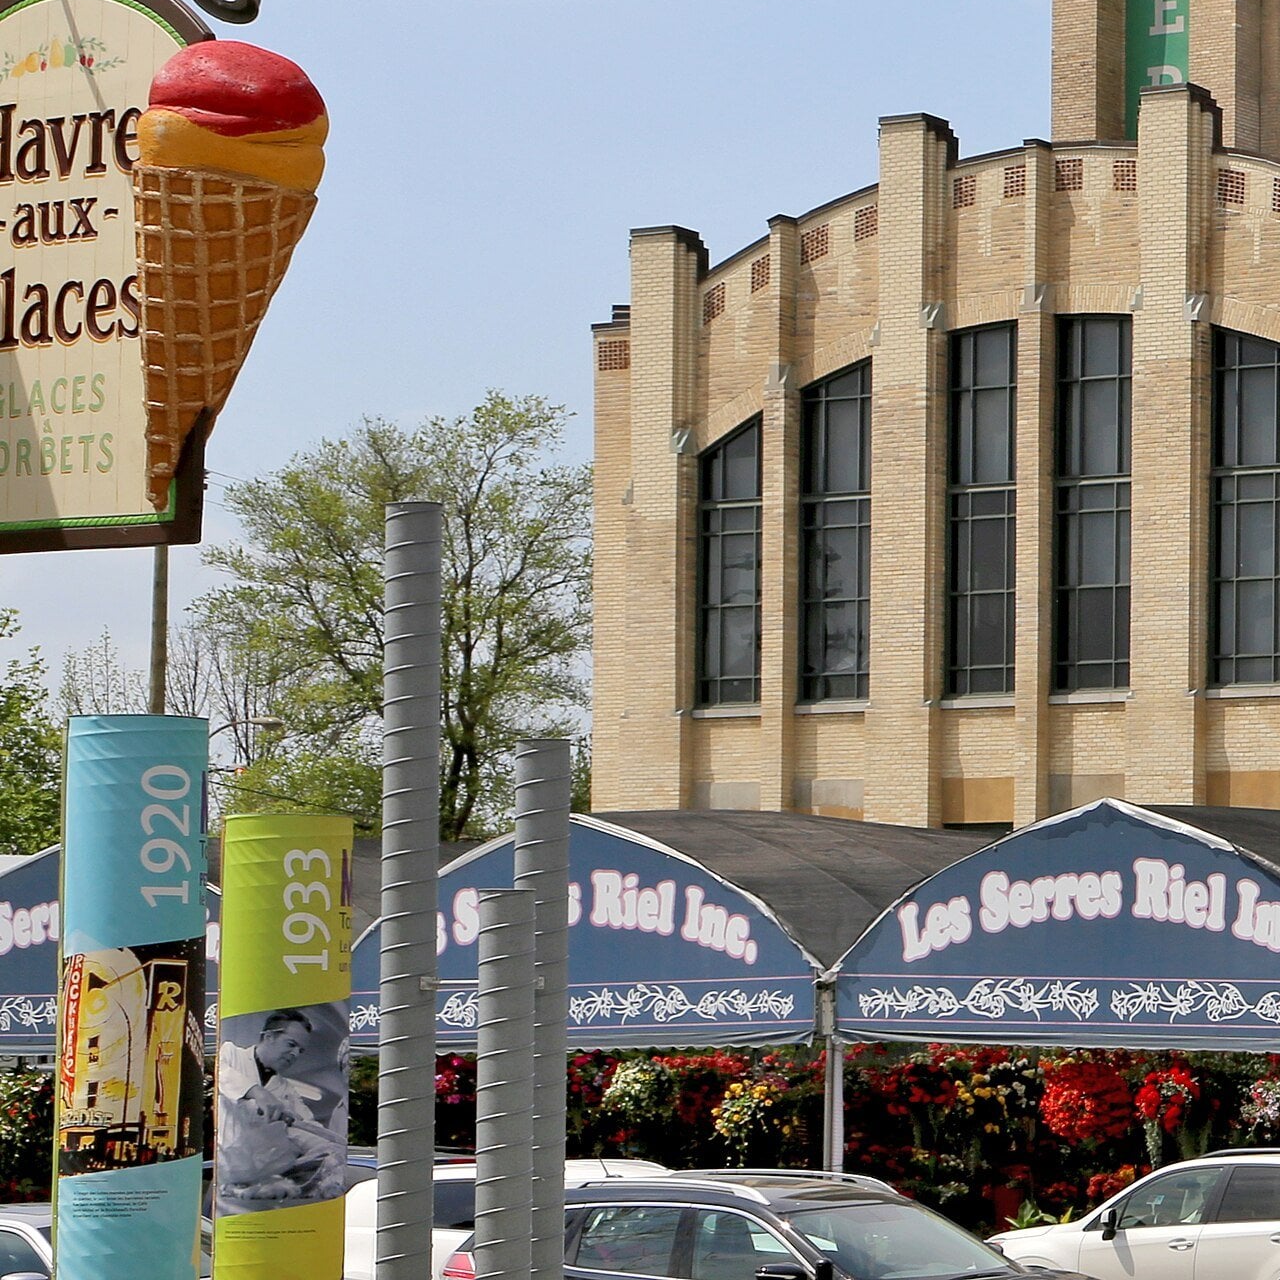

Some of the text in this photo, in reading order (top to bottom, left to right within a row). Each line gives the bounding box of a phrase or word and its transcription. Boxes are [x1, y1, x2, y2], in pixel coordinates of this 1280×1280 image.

[0, 266, 140, 352] laces
[0, 432, 115, 477] ORBETS
[140, 764, 192, 908] 1920
[282, 848, 332, 975] 1933
[590, 869, 677, 936] Riel
[681, 885, 758, 965] Inc.
[898, 896, 972, 963] Les
[979, 870, 1123, 934] Serres
[1131, 857, 1227, 933] Riel
